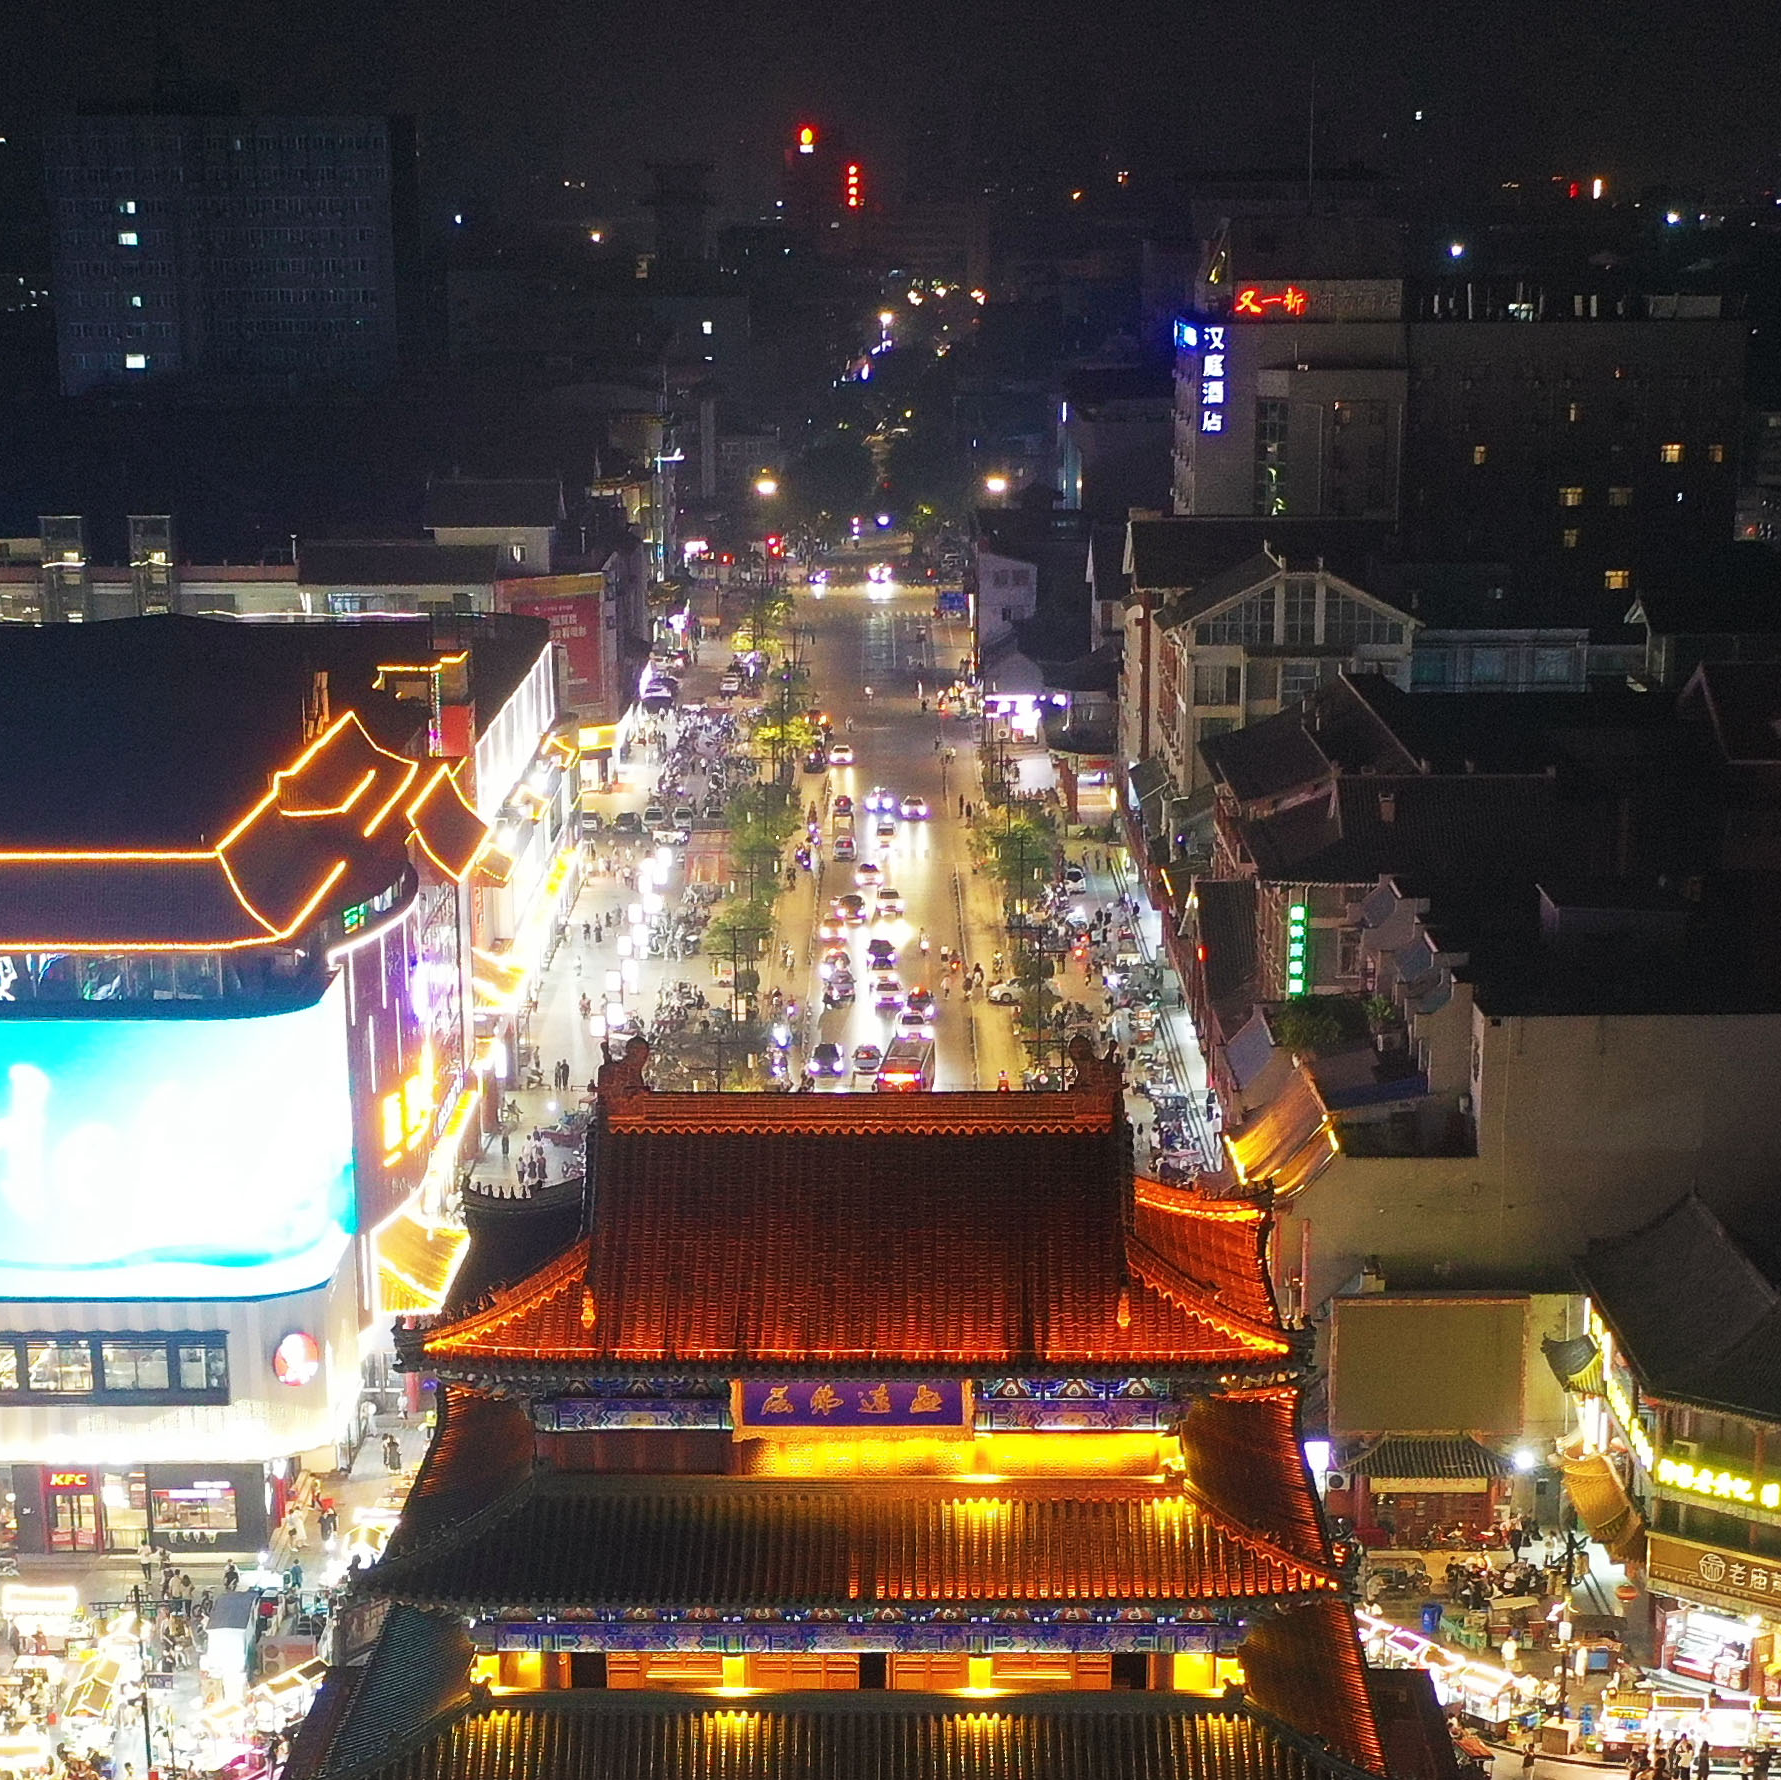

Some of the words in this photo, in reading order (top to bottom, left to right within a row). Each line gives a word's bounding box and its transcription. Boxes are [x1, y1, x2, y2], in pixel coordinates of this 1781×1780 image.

[1202, 327, 1224, 432] 汉庭酒店
[49, 1473, 87, 1486] KFC
